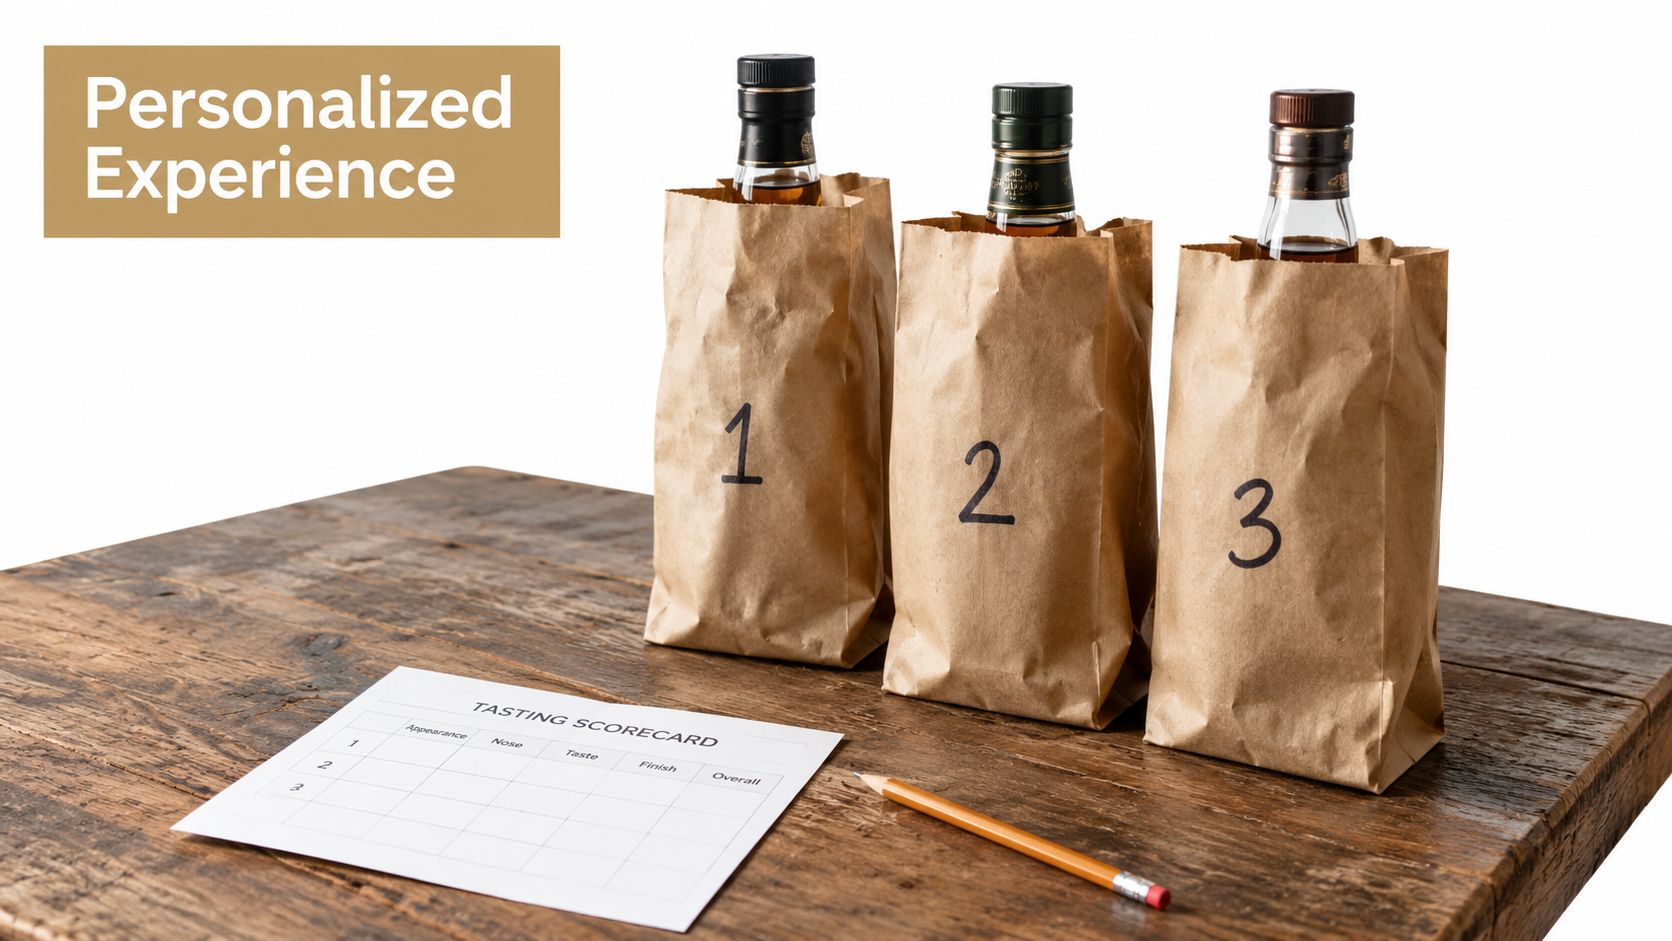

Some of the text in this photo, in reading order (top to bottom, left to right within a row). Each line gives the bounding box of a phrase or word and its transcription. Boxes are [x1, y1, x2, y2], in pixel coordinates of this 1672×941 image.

[721, 402, 764, 486] 1
[959, 440, 1016, 526] 2
[1228, 478, 1282, 569] 3
[347, 739, 361, 749] 1
[472, 702, 719, 747] TASTING SCORECARD
[316, 760, 334, 770] 2
[403, 723, 763, 786] Appearance Nose Taste Finish Overall
[288, 782, 306, 793] 3
